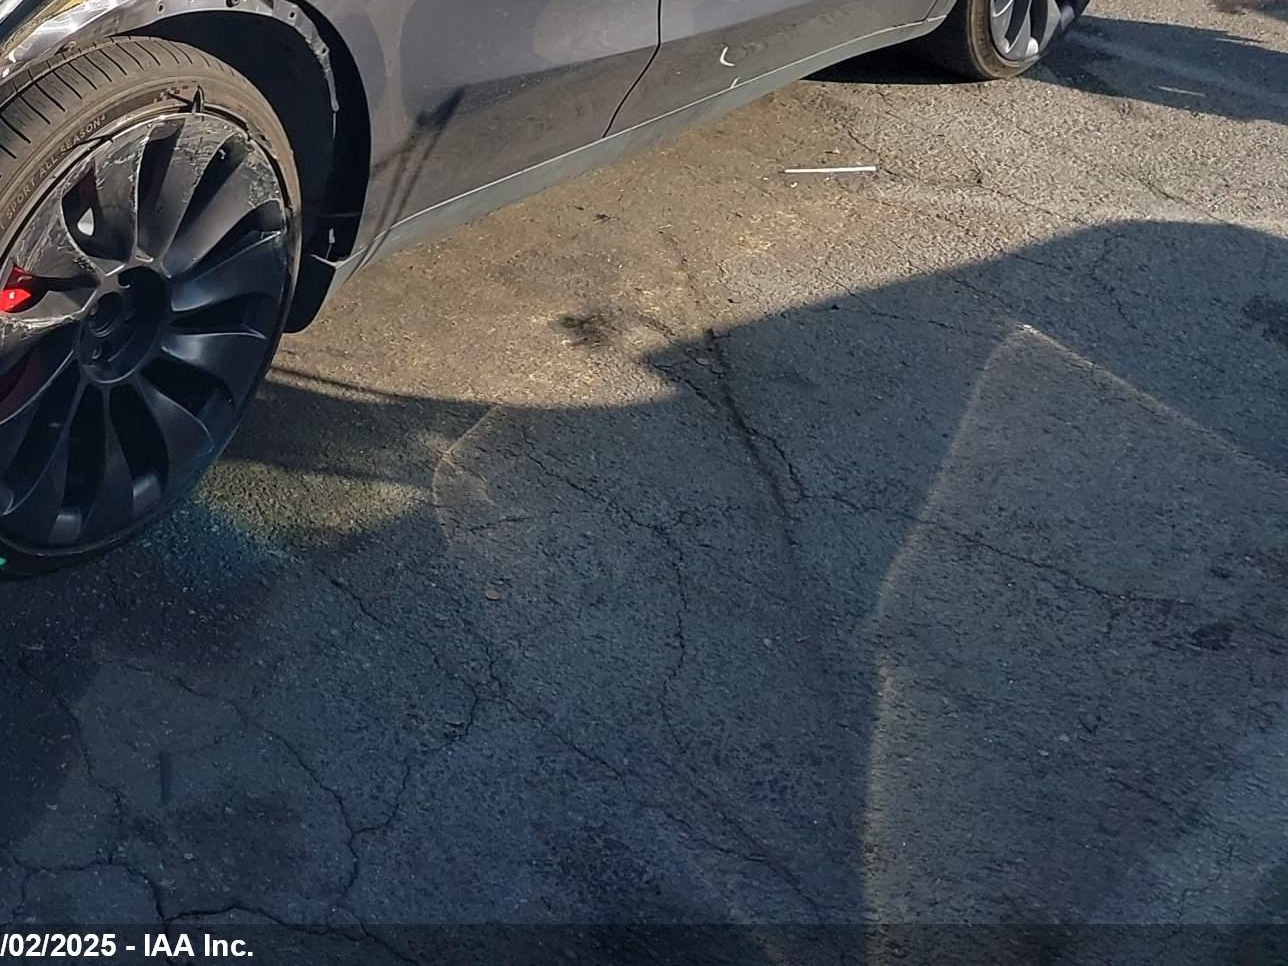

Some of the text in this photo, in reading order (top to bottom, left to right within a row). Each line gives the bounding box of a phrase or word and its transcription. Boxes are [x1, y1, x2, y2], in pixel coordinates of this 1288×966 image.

[6, 177, 36, 219] SPORT
[39, 156, 59, 179] ALL
[60, 117, 101, 156] SEASON
